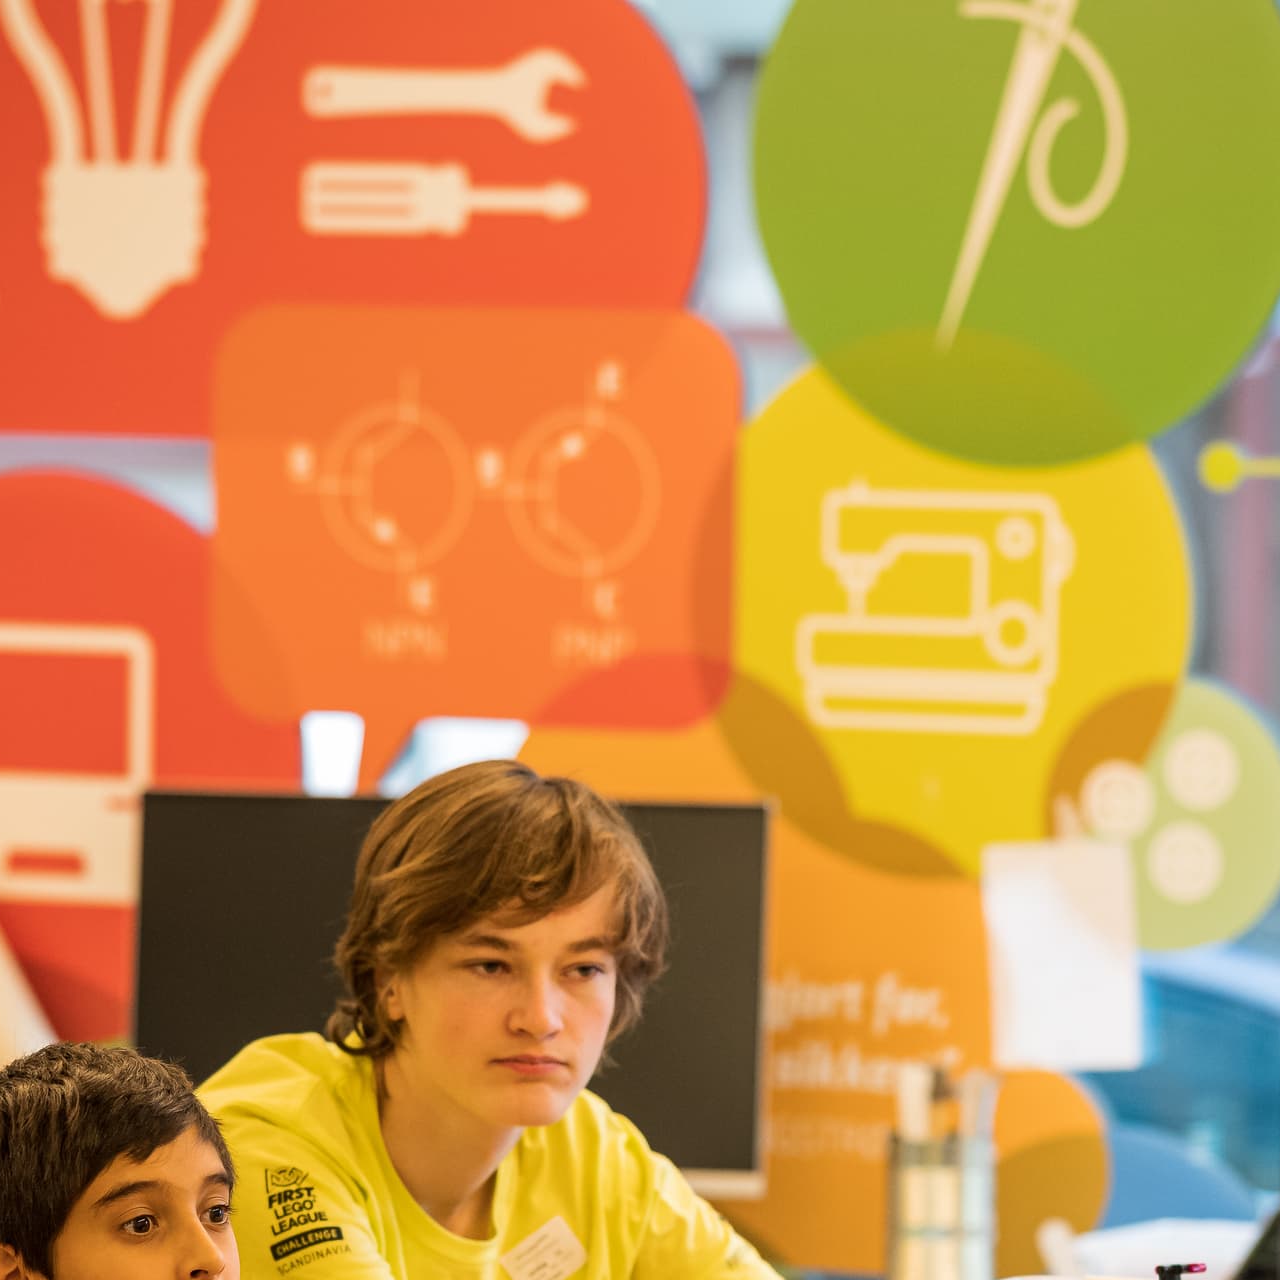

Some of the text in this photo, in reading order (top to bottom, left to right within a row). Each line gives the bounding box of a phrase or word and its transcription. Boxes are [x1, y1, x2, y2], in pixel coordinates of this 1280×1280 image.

[268, 1187, 314, 1209] FIRST
[274, 1199, 314, 1220] LEGO
[271, 1211, 328, 1236] LEAGUE
[276, 1229, 338, 1257] CHALLENGE
[277, 1244, 352, 1276] SCANDINAVIA
